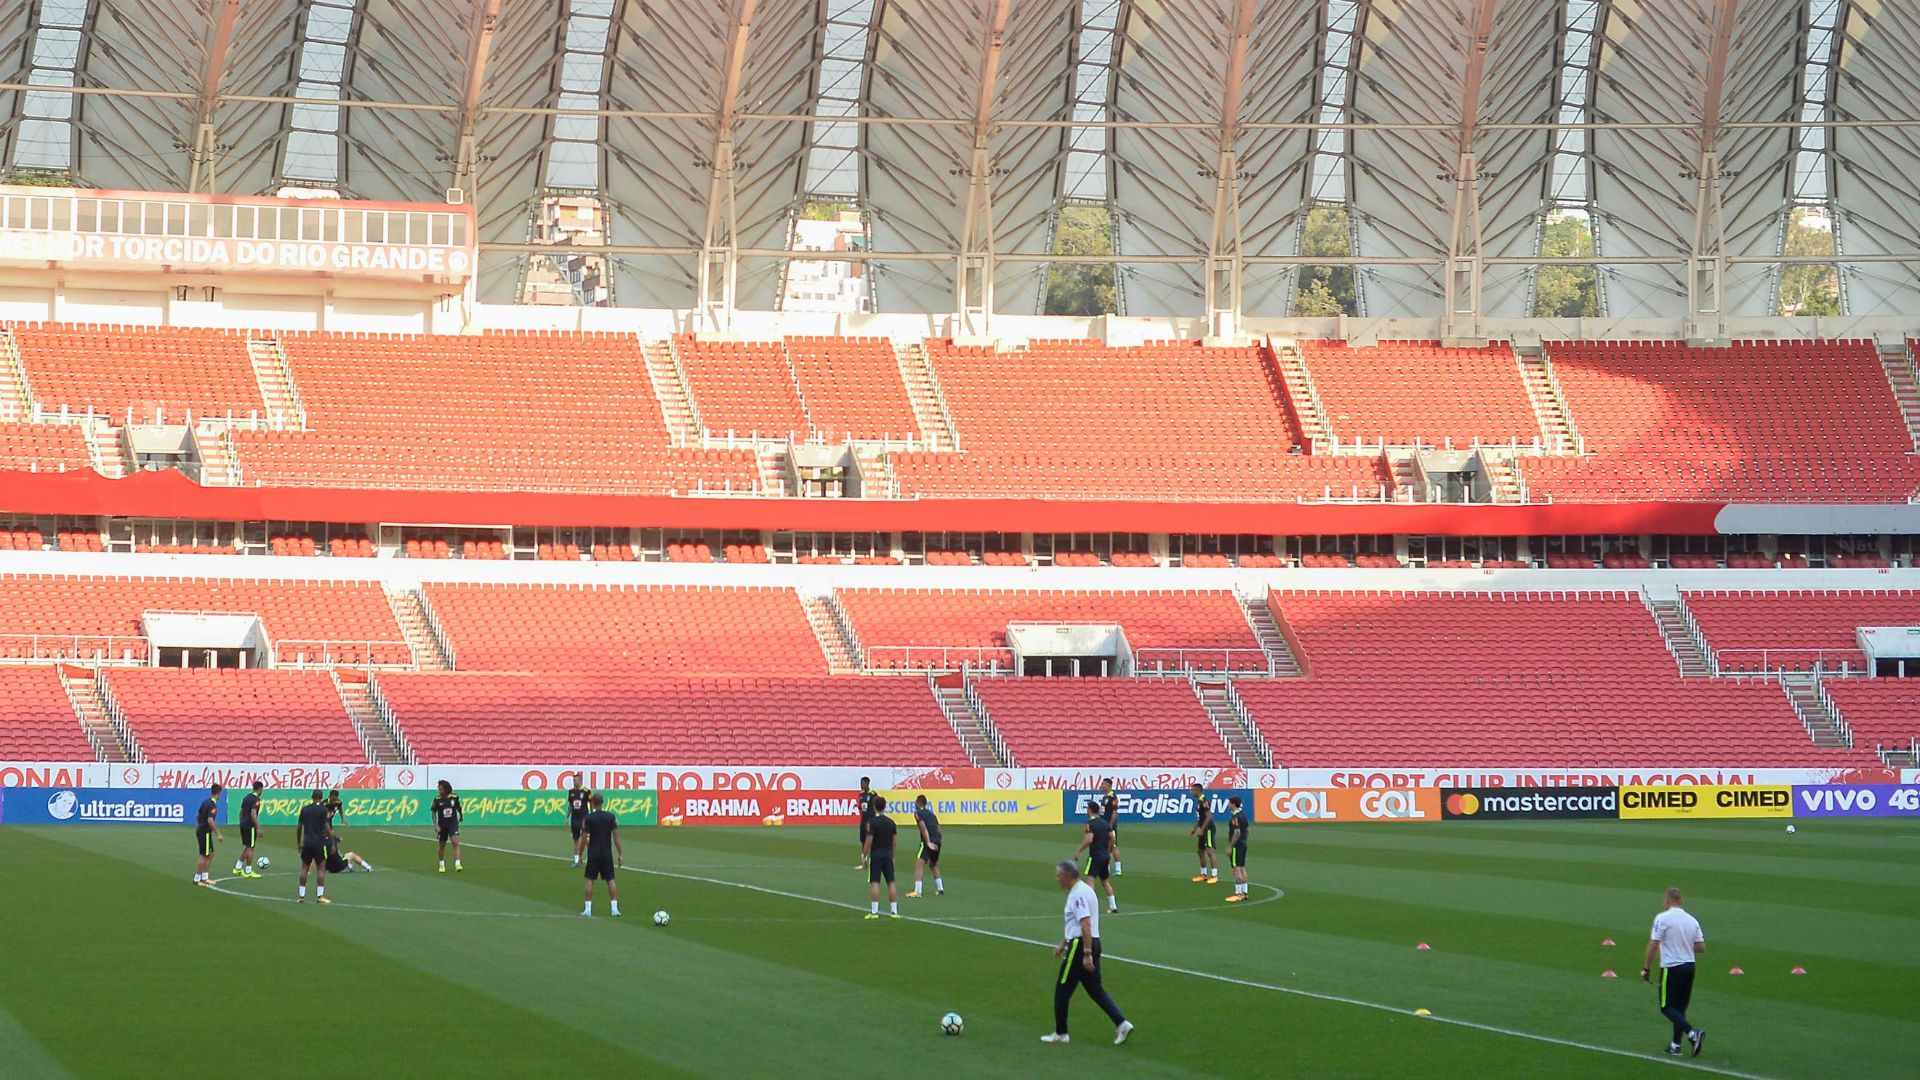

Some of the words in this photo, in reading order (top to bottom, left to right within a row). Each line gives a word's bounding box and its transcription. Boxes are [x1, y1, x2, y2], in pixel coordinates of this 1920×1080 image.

[110, 235, 230, 264] TORCIDA
[237, 241, 275, 265] DO
[279, 242, 327, 267] RIO
[331, 244, 445, 271] GRANDE
[80, 800, 184, 818] ultrafarma
[344, 795, 419, 821] SELEÇÃO
[460, 796, 527, 818] IGANTES
[532, 797, 567, 816] POR
[686, 798, 760, 817] BRAHMA
[787, 798, 860, 817] BRAHMA
[938, 801, 956, 813] EM
[960, 801, 1019, 814] NIKE.COM
[1116, 793, 1194, 819] English
[1270, 791, 1337, 820] GOL
[1359, 790, 1425, 819] GOL
[1484, 791, 1616, 812] mastercard
[1623, 791, 1698, 809] CIMED
[1716, 790, 1790, 808] CIMED
[1801, 789, 1876, 812] VIVO
[1888, 789, 1919, 810] 4G
